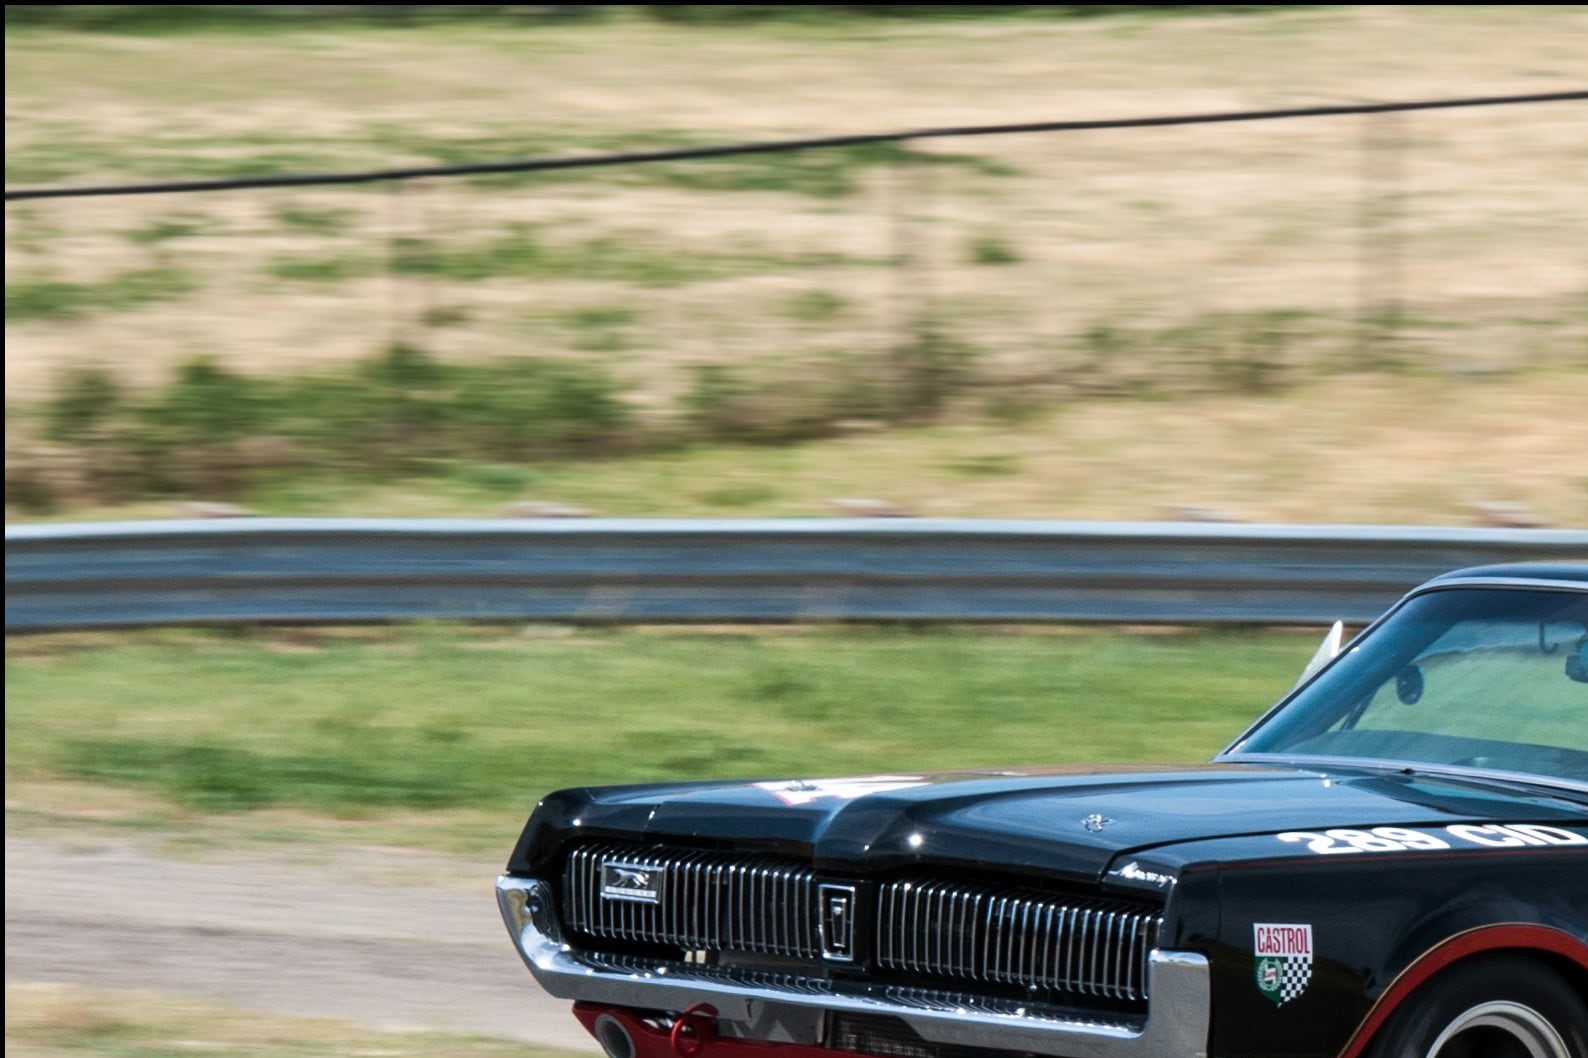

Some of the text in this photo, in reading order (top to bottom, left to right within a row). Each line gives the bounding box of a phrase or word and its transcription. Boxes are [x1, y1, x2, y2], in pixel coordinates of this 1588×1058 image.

[1277, 824, 1588, 854] 289 CID
[1257, 927, 1310, 953] CASTROL
